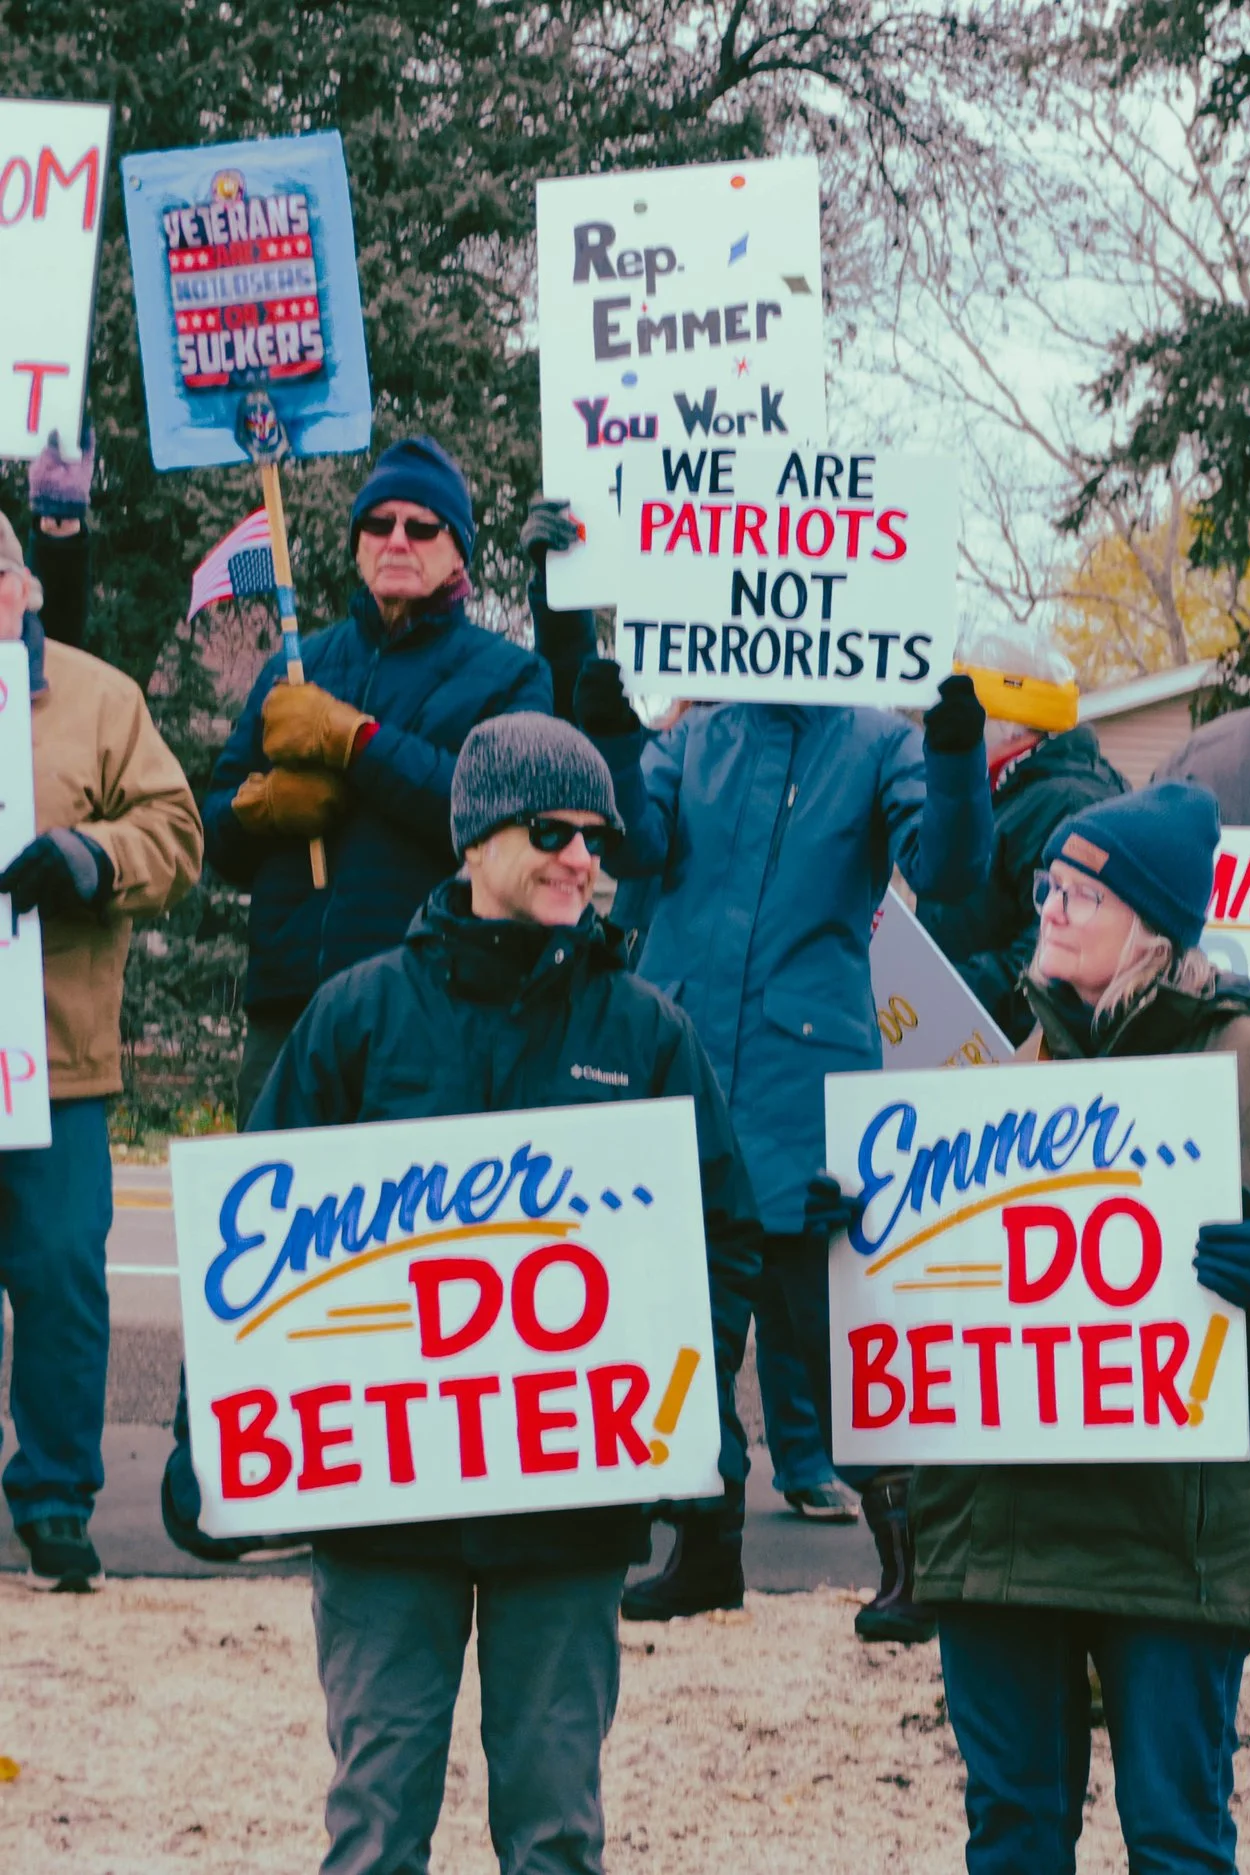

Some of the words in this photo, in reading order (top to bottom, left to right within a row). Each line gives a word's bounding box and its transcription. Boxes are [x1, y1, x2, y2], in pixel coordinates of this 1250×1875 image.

[162, 194, 309, 249] VETERANS
[572, 220, 686, 297] Rep.
[177, 320, 324, 376] SUCKERS
[573, 395, 659, 448] You
[673, 383, 788, 439] Work
[661, 448, 736, 495] WE
[776, 451, 877, 501] ARE
[640, 500, 908, 561] PATRIOTS
[731, 567, 848, 621] NOT
[622, 618, 932, 682] TERRORISTS
[583, 1064, 629, 1087] Columbia
[846, 1092, 1202, 1257] Emmer...
[203, 1141, 655, 1322] Emmer...
[1001, 1196, 1164, 1308] DO
[407, 1242, 611, 1360] DO
[847, 1312, 1231, 1430] BETTER!
[210, 1346, 702, 1501] BETTER!
